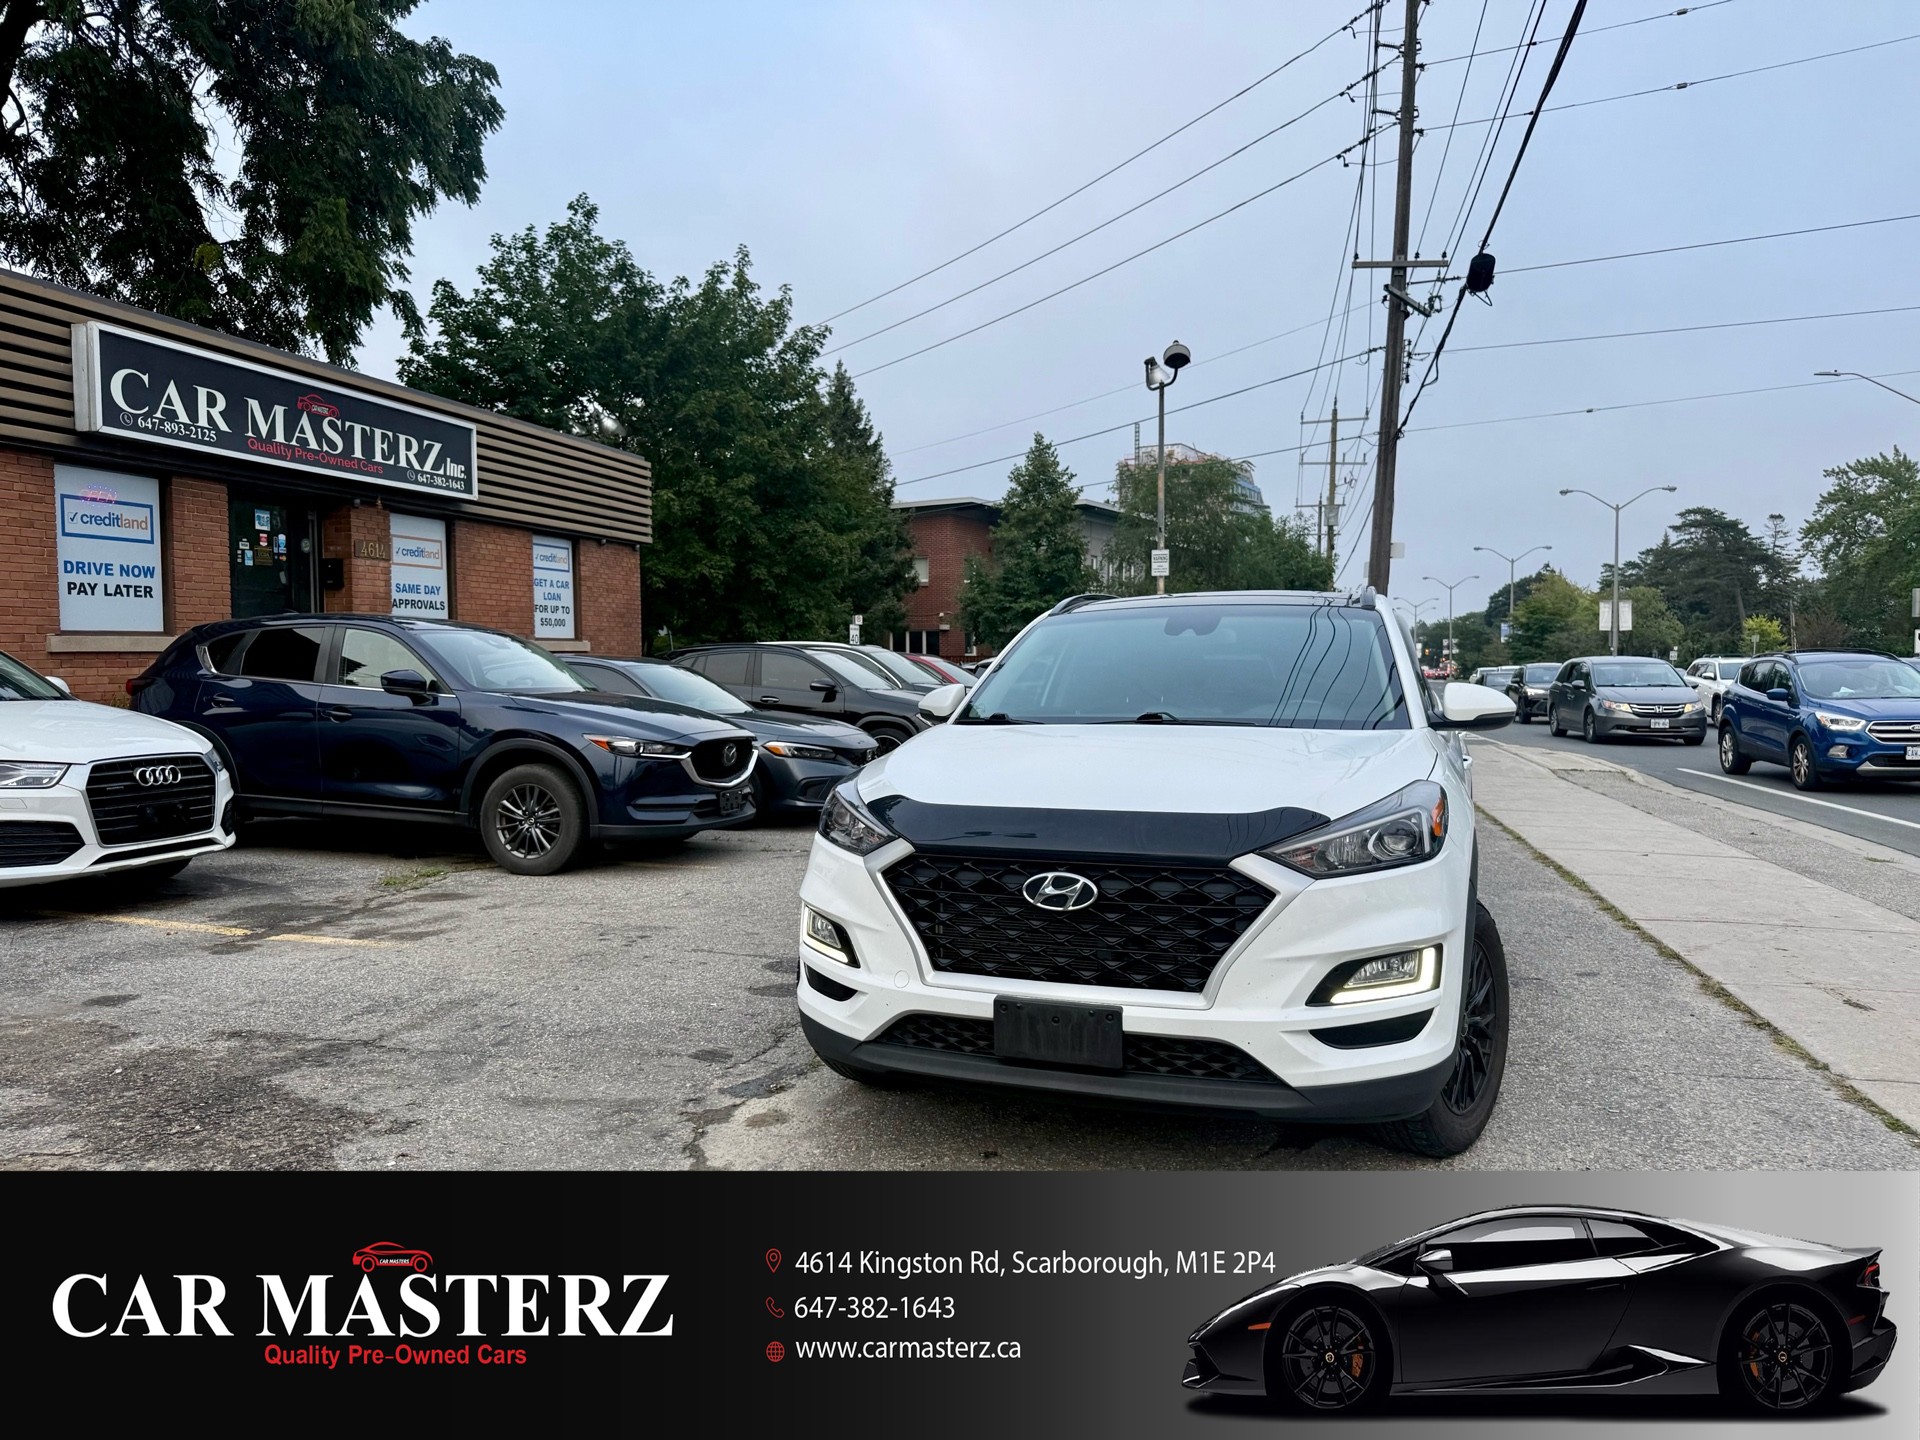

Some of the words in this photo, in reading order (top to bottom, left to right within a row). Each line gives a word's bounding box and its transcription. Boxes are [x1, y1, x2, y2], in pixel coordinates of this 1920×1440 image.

[110, 368, 232, 433] CAR
[244, 397, 445, 474] MASTERZ
[138, 415, 217, 442] 647-893-2125
[247, 438, 292, 460] Quality
[295, 447, 358, 469] Pre-Owned
[360, 460, 384, 474] Cars
[446, 457, 467, 480] Inc.
[417, 473, 465, 491] 647-382-1643
[80, 511, 148, 531] creditland
[361, 541, 386, 559] 4614
[401, 546, 440, 560] creditland
[63, 560, 114, 577] DRIVE
[119, 564, 156, 579] NOW
[67, 581, 98, 596] PAY
[103, 583, 154, 599] LATER
[395, 583, 421, 595] SAME
[424, 584, 441, 596] DAY
[534, 578, 548, 588] GET
[549, 579, 555, 588] A
[555, 580, 570, 590] CAR
[392, 598, 446, 611] APPROVALS
[543, 591, 562, 602] LOAN
[534, 604, 549, 614] FOR
[550, 605, 560, 615] UP
[560, 606, 571, 615] TO
[540, 617, 566, 629] $50,000
